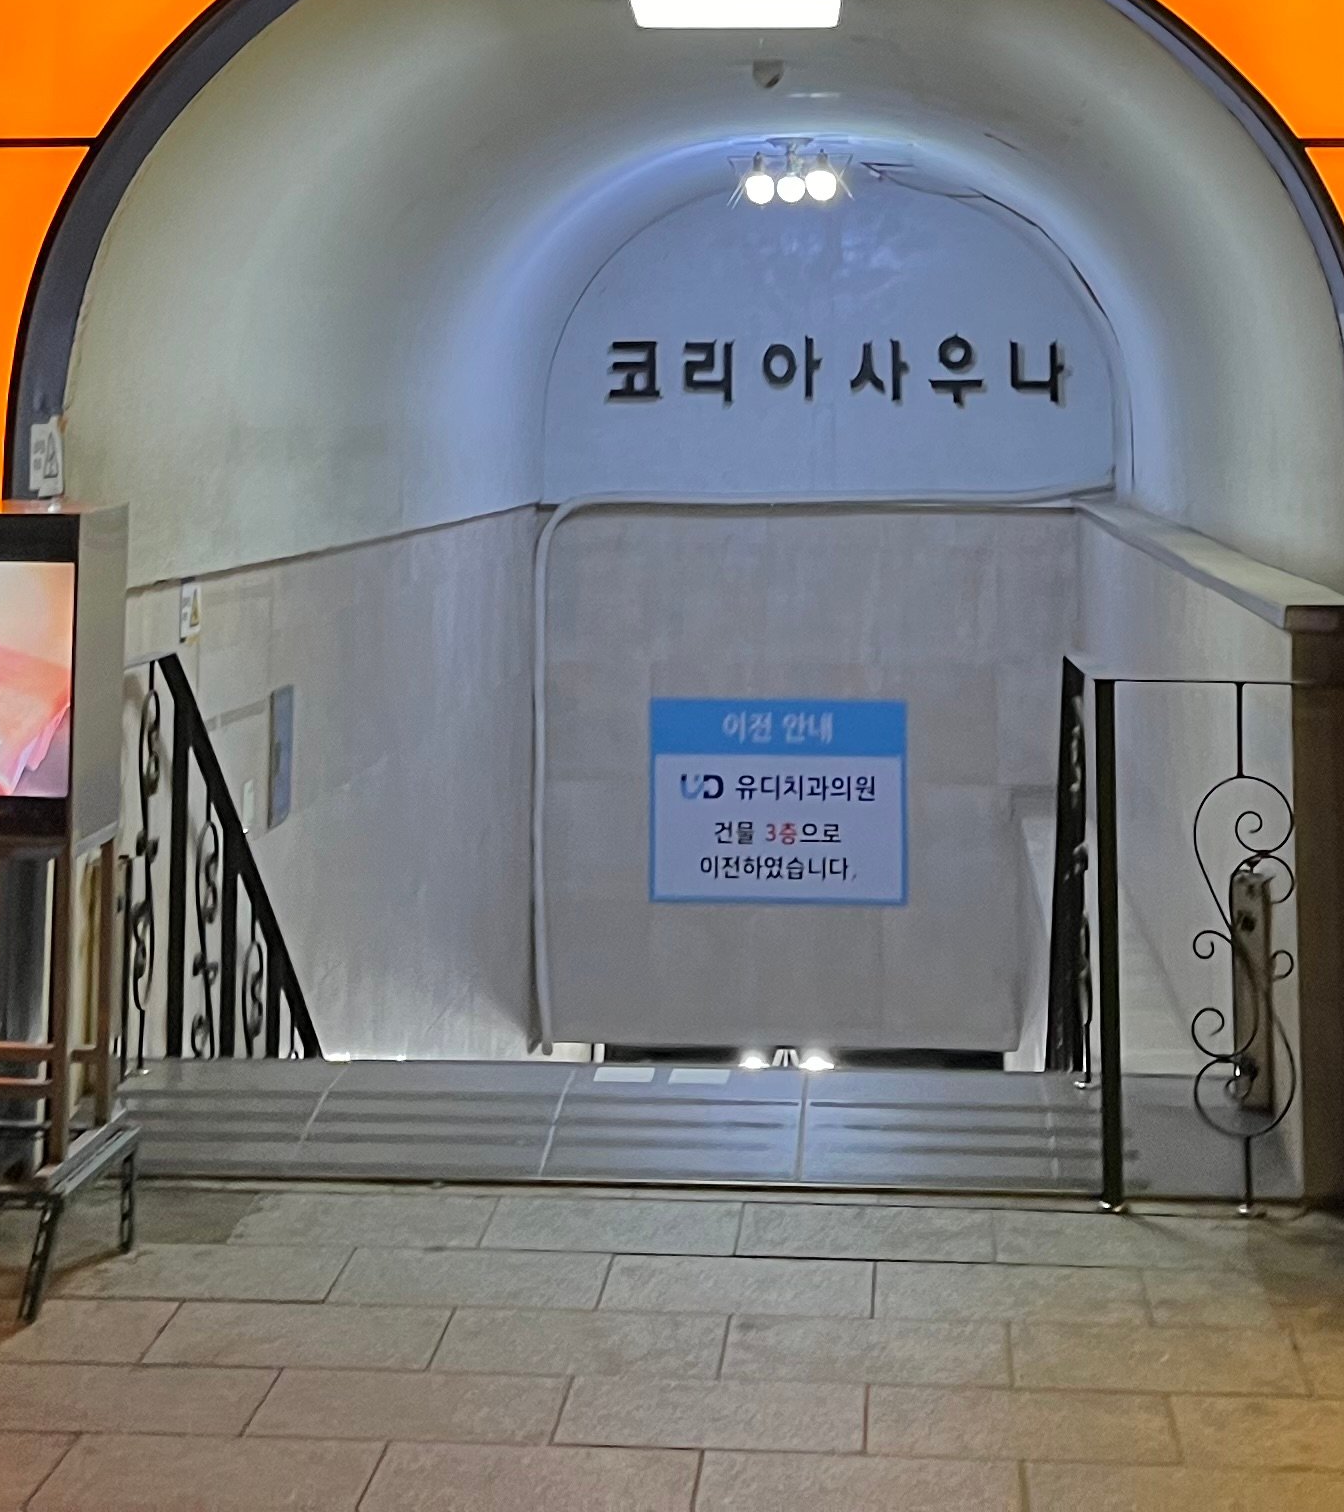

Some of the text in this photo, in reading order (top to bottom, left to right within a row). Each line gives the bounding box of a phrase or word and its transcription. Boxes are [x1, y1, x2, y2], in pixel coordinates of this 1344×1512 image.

[606, 334, 1072, 408] 코리아사우나
[722, 711, 835, 744] 이전 안내
[735, 774, 876, 802] 유디치과의원
[714, 821, 842, 845] 건물 3층으로
